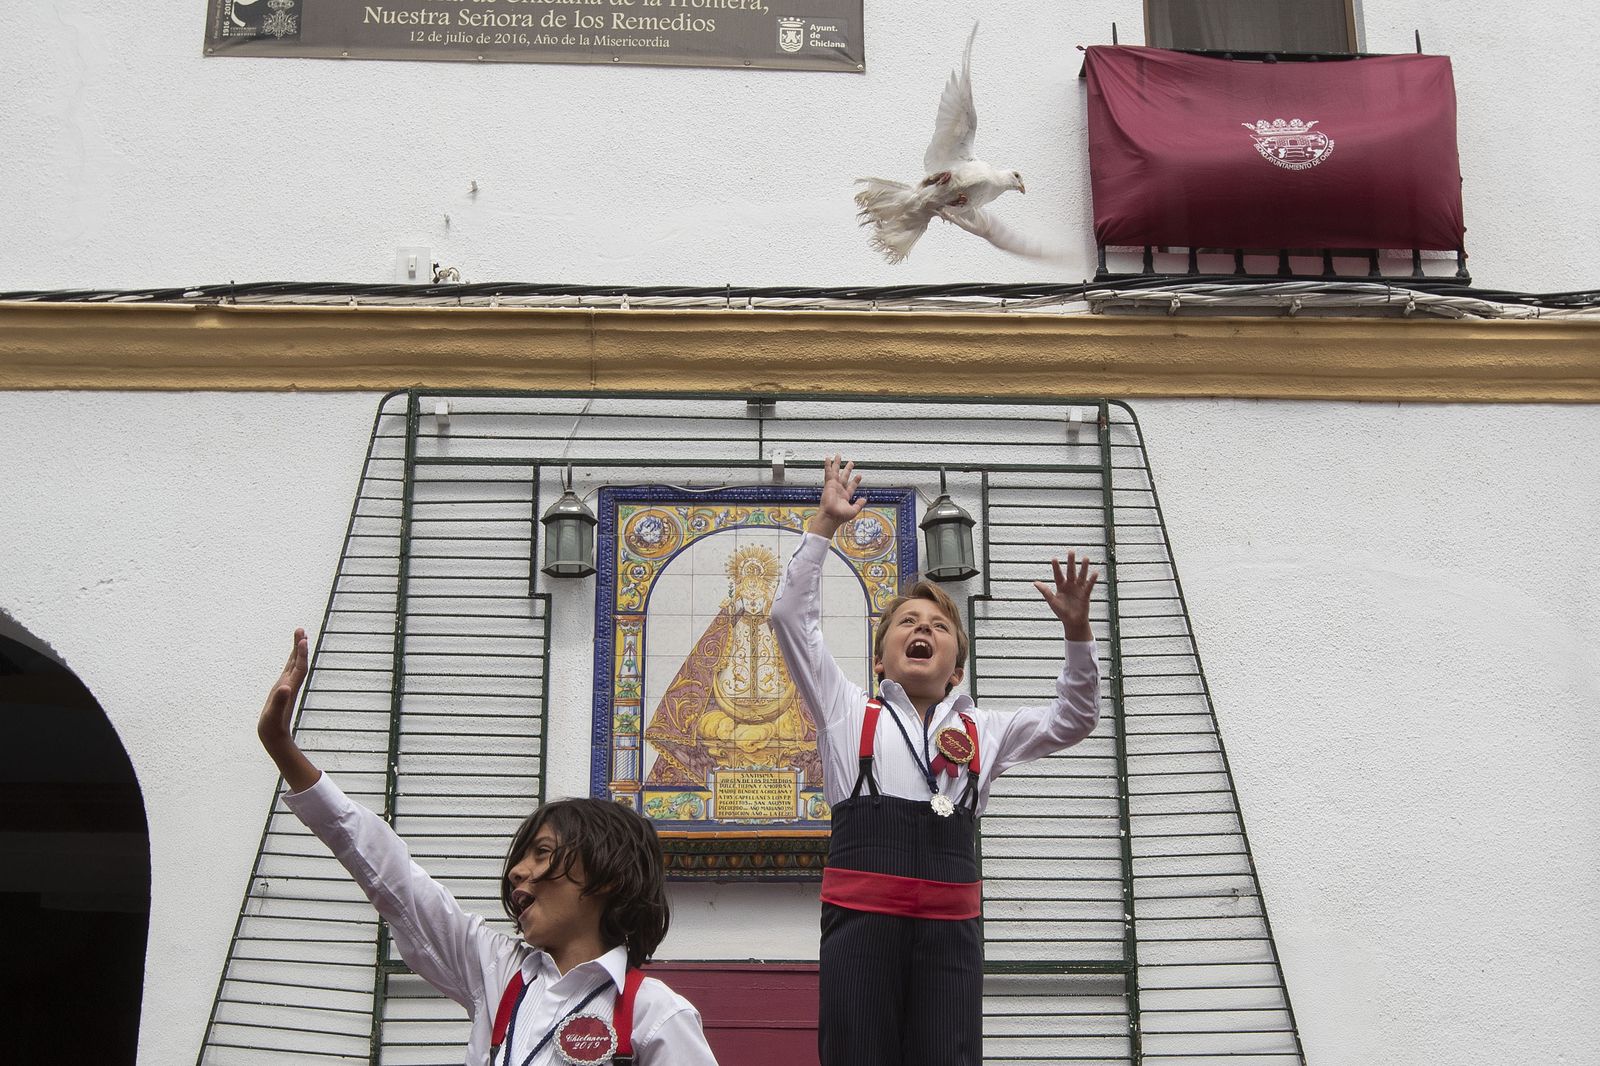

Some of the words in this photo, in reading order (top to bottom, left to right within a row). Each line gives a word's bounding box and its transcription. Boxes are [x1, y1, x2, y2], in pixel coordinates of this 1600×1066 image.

[363, 6, 450, 25] Nuestra
[458, 9, 534, 27] Señora
[541, 10, 567, 28] de
[574, 10, 604, 29] los
[611, 12, 716, 32] Remedios
[810, 24, 838, 32] Ayunt.
[410, 31, 424, 42] 12
[428, 31, 442, 42] de
[444, 31, 473, 45] julio
[476, 32, 491, 44] de
[494, 33, 530, 46] 2016,
[534, 33, 558, 45] Año
[561, 34, 576, 45] de
[579, 35, 590, 45] la
[594, 35, 670, 47] Misericordia
[810, 40, 846, 48] Chiclana
[566, 1033, 609, 1042] Chiclanero
[572, 1041, 600, 1050] 2019
